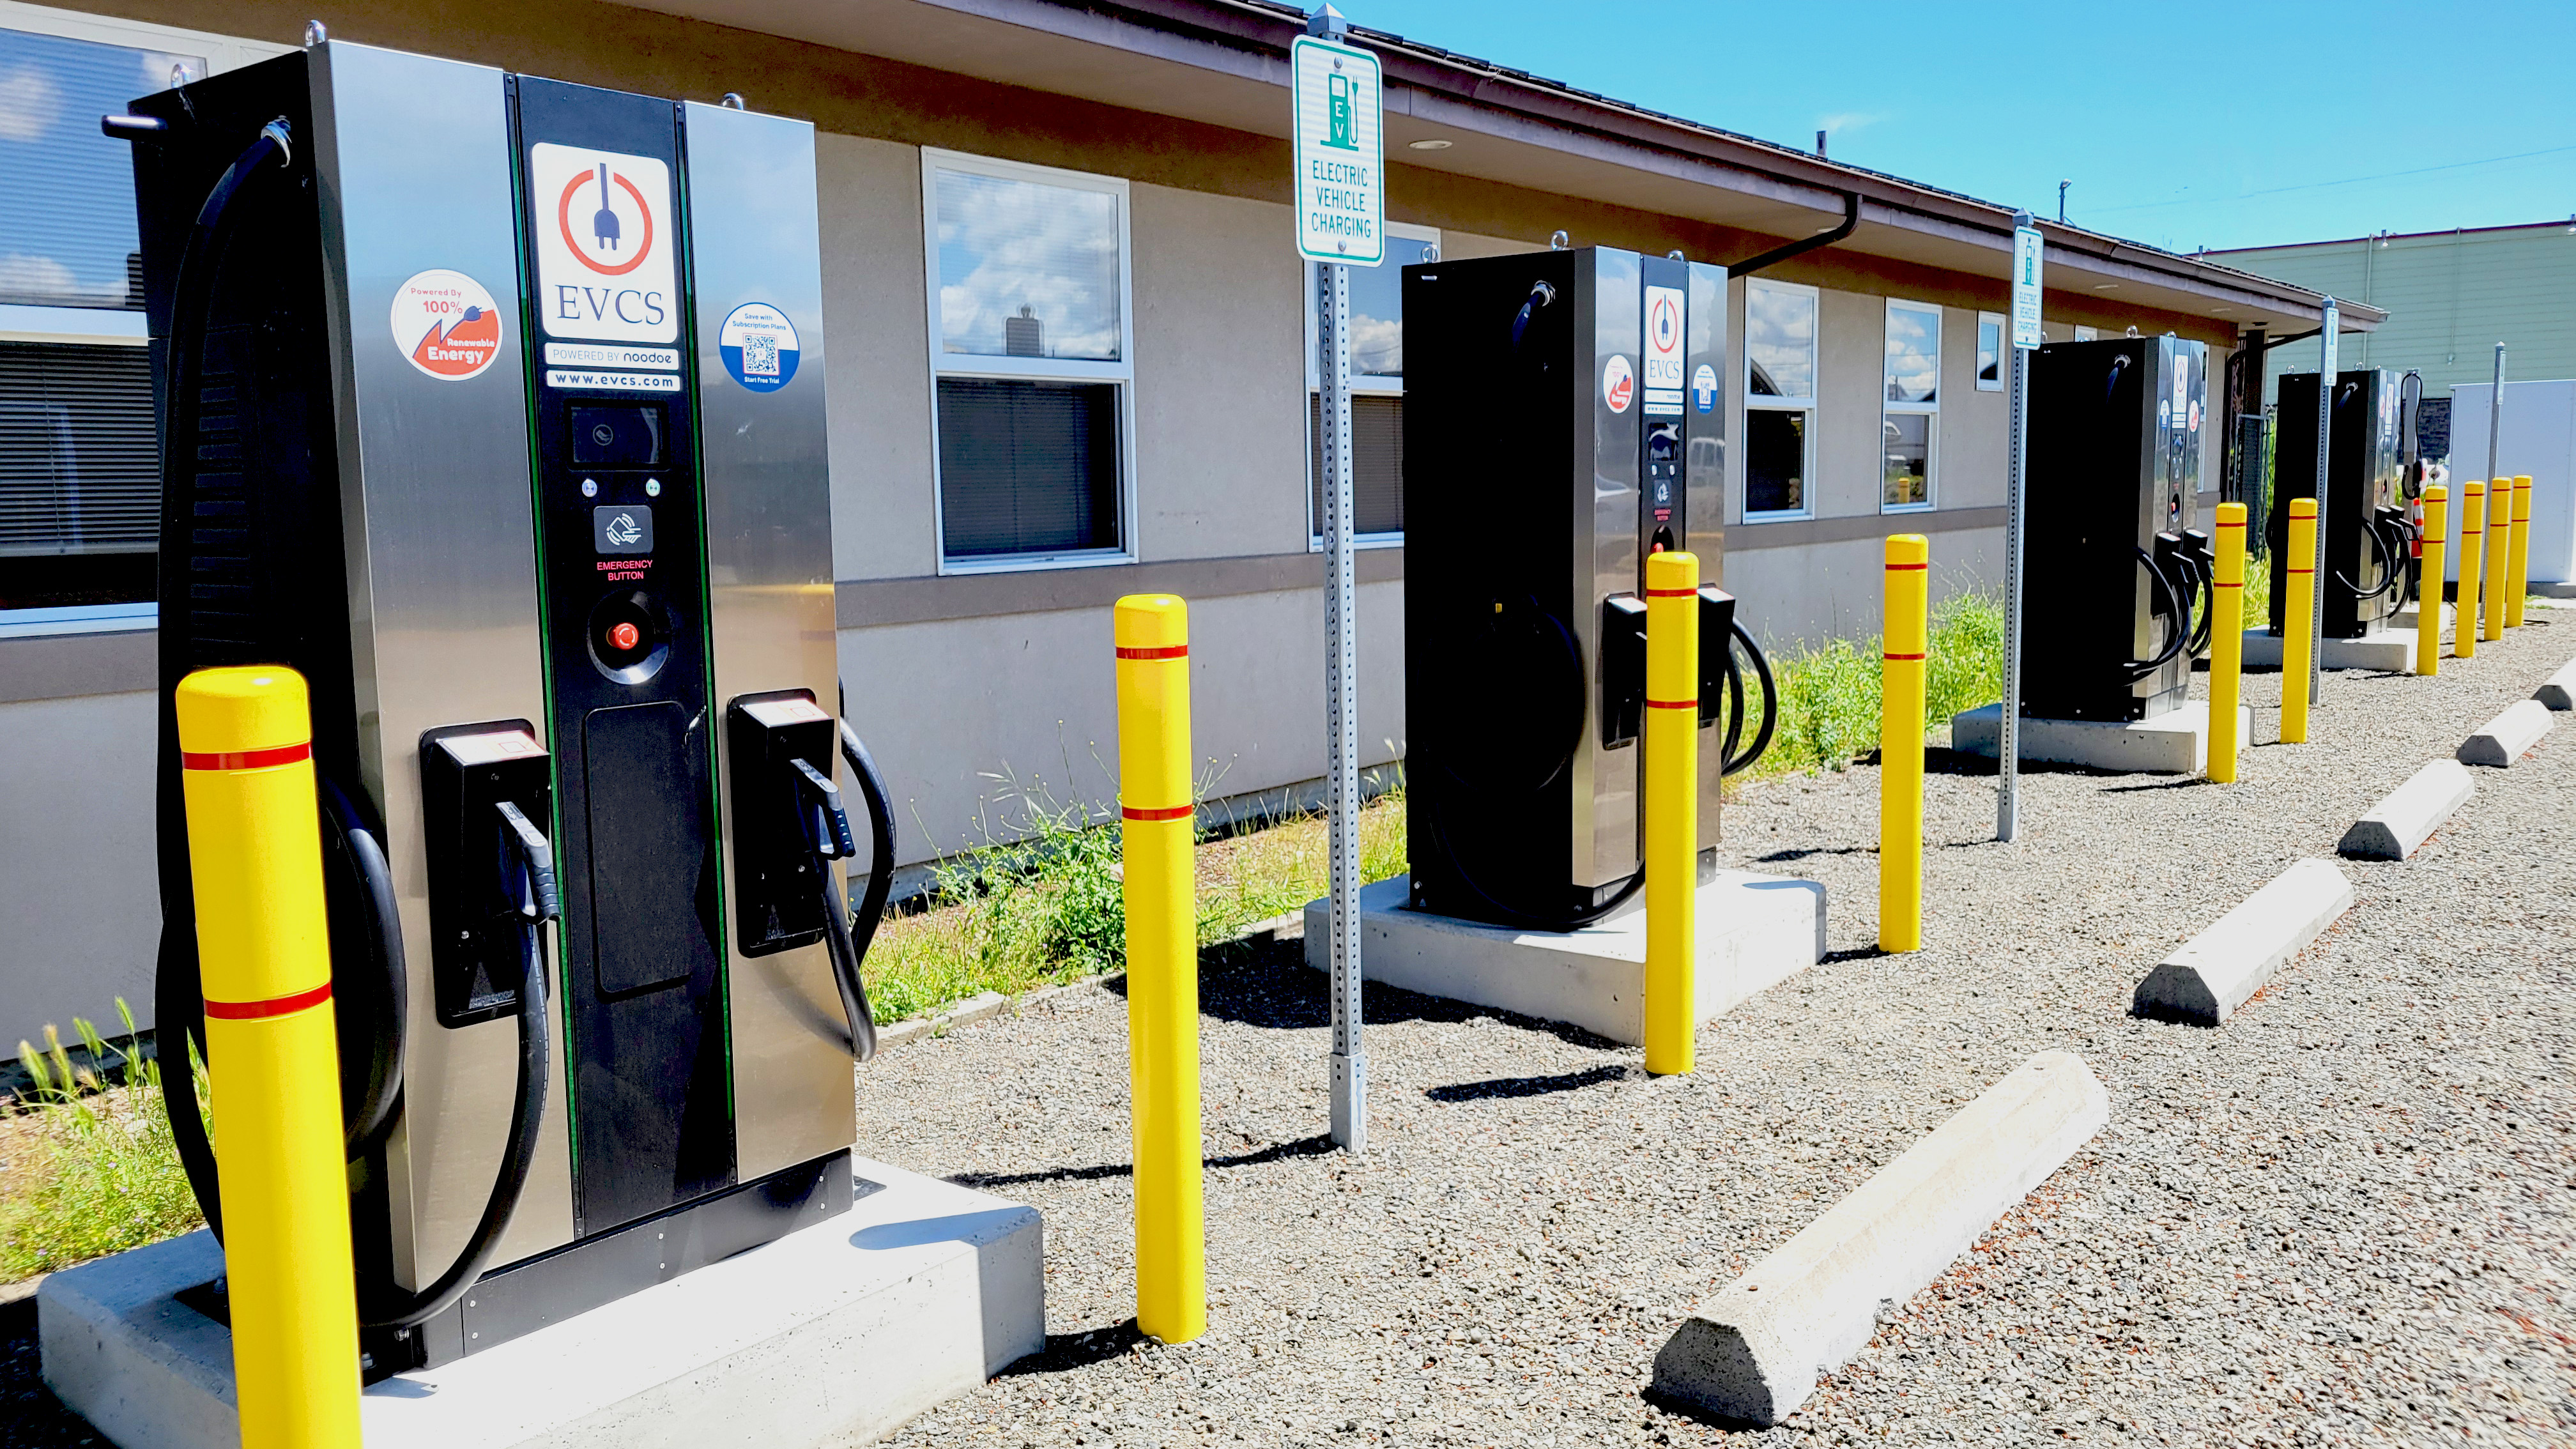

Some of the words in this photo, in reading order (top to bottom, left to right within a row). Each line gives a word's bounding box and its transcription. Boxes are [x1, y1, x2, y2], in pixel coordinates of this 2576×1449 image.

[1313, 160, 1368, 187] ELECTRIC
[1316, 186, 1366, 212] VEHICLE
[1312, 212, 1372, 238] CHARGING
[411, 288, 448, 296] Powered
[451, 289, 461, 298] By
[423, 300, 463, 314] 100%
[555, 284, 664, 325] EVCS
[732, 320, 770, 330] Subscription
[447, 338, 495, 348] Renewable
[427, 346, 484, 365] Energy
[553, 349, 604, 362] POWERED
[608, 352, 620, 362] BY
[624, 353, 671, 364] noodoe
[1650, 359, 1680, 379] EVCS
[555, 374, 673, 387] www.evcs.com
[597, 559, 653, 571] EMERGENCY
[608, 571, 645, 581] BUTTON
